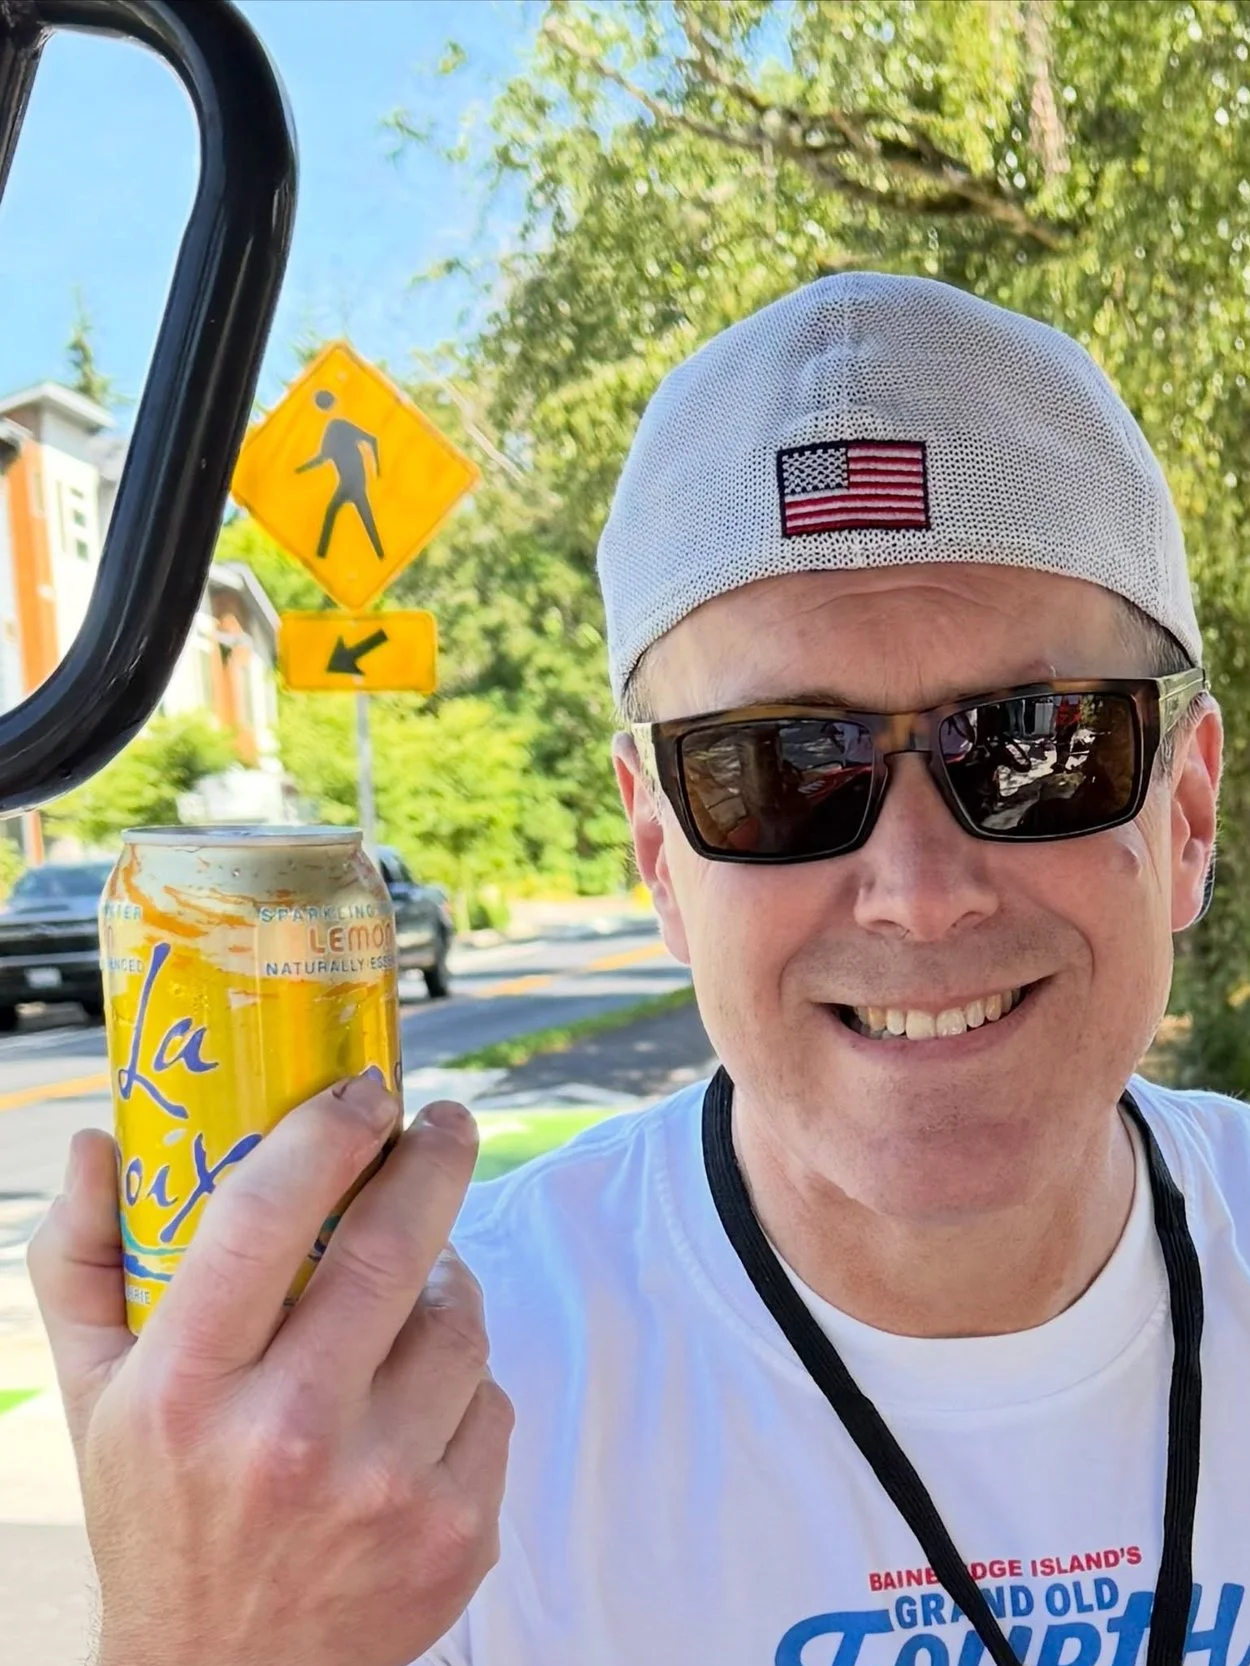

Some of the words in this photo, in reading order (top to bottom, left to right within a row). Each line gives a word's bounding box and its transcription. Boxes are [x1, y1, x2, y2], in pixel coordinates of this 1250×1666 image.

[259, 903, 374, 923] SPARKLING
[265, 957, 364, 976] NATURALLY
[118, 942, 220, 1120] La
[125, 1132, 263, 1243] oix
[869, 1560, 1023, 1592] BAINBDGE
[1031, 1546, 1142, 1578] ISLAND'S
[1045, 1577, 1119, 1617] OLD
